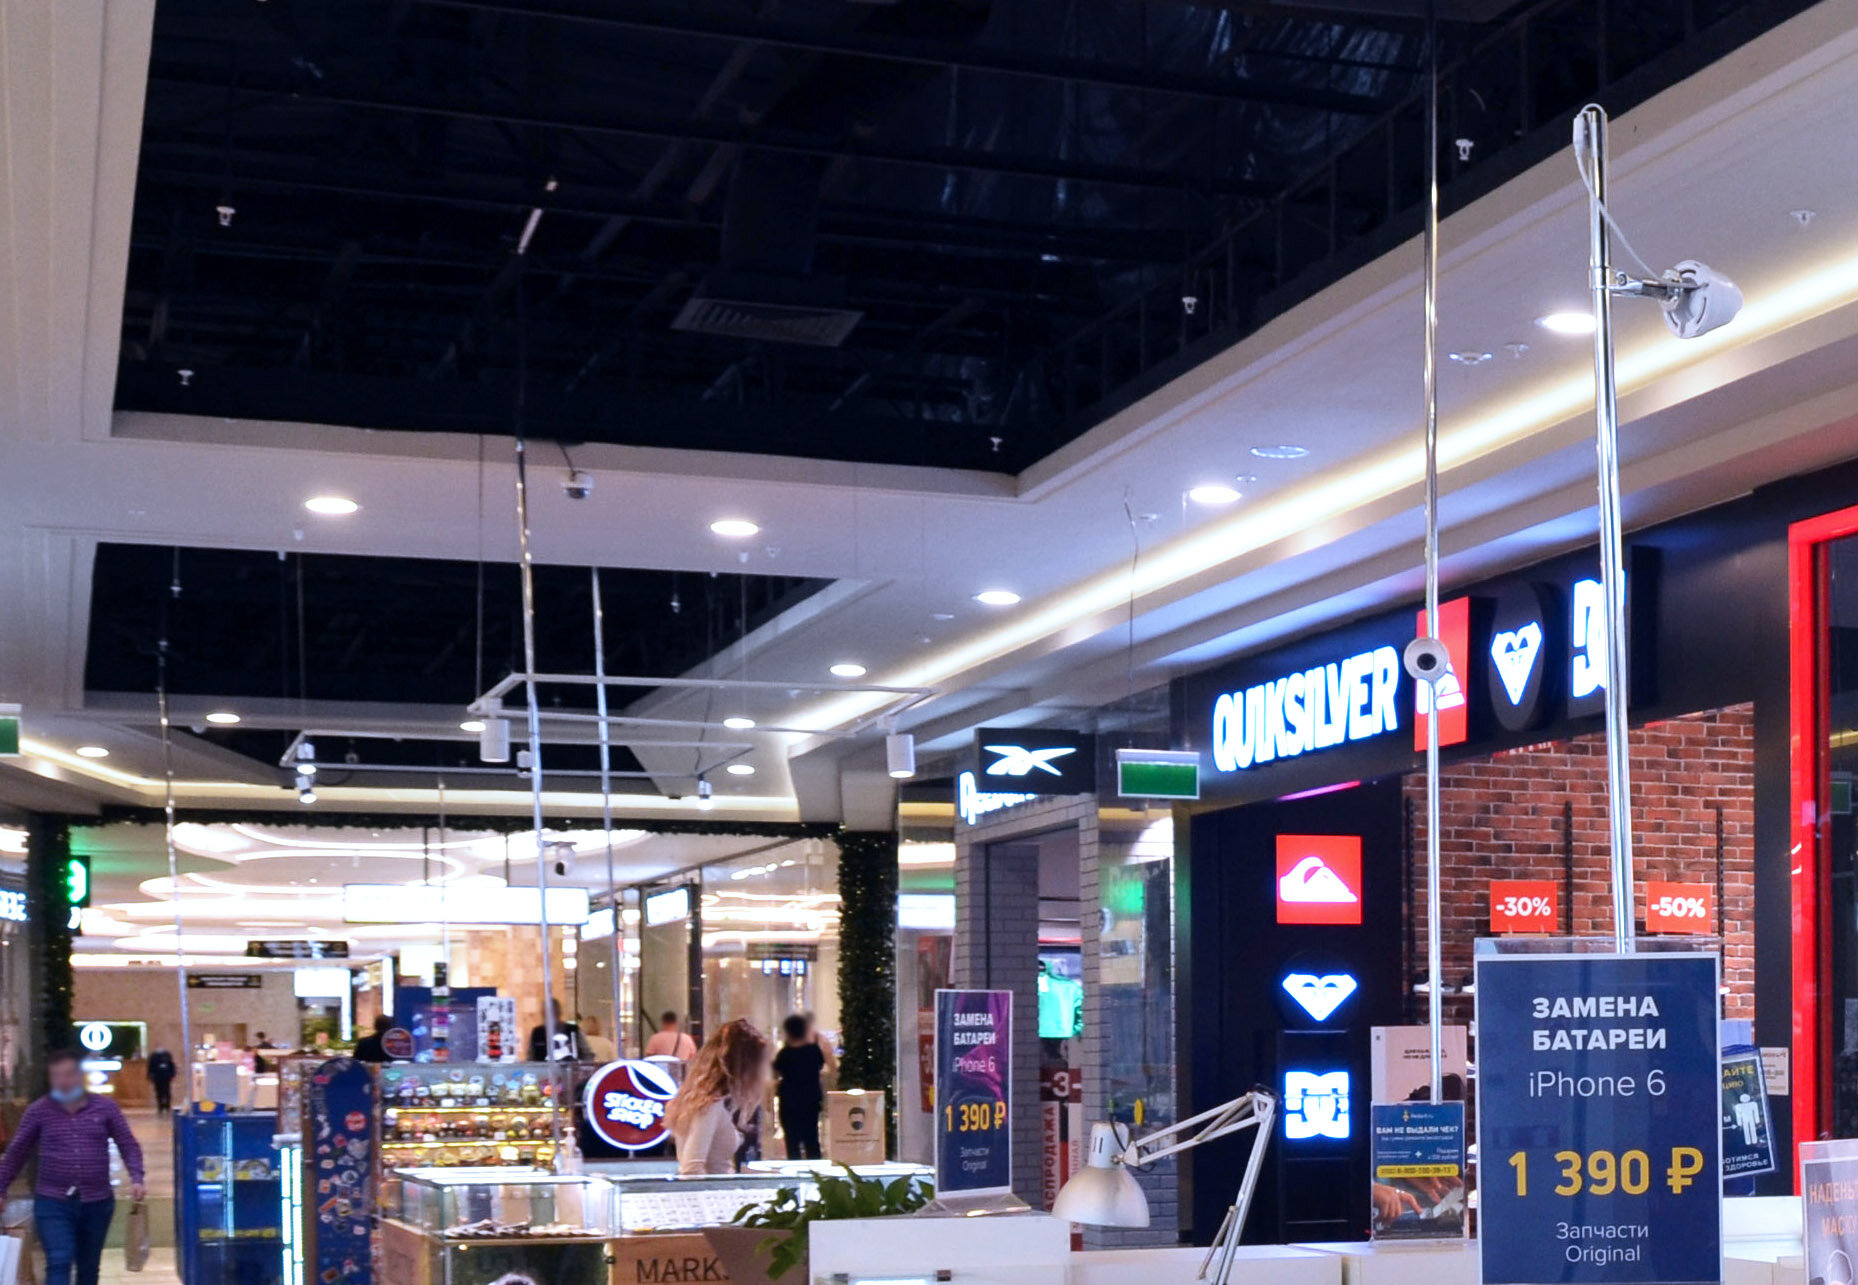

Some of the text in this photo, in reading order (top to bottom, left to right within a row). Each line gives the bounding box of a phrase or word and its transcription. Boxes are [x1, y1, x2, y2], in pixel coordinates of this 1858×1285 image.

[1212, 645, 1399, 772] QUIKSILVER
[1495, 895, 1551, 918] -30%
[1650, 896, 1706, 919] -50%
[1532, 996, 1659, 1018] ЗАМЕНА
[953, 1013, 994, 1026] ЗАМЕНА
[953, 1032, 996, 1045] БАТАРЕИ
[1532, 1027, 1667, 1052] БАТАРЕИ
[952, 1057, 986, 1073] iPhone
[988, 1056, 996, 1073] 6
[1529, 1069, 1666, 1098] iPhone 6
[606, 1107, 654, 1130] SHOP
[946, 1105, 953, 1132] 1
[959, 1103, 990, 1132] 390
[1394, 1126, 1404, 1134] НЕ
[1508, 1151, 1527, 1197] 1
[1555, 1149, 1650, 1196] 390
[1556, 1221, 1649, 1241] Запчасти
[1565, 1244, 1641, 1264] Original
